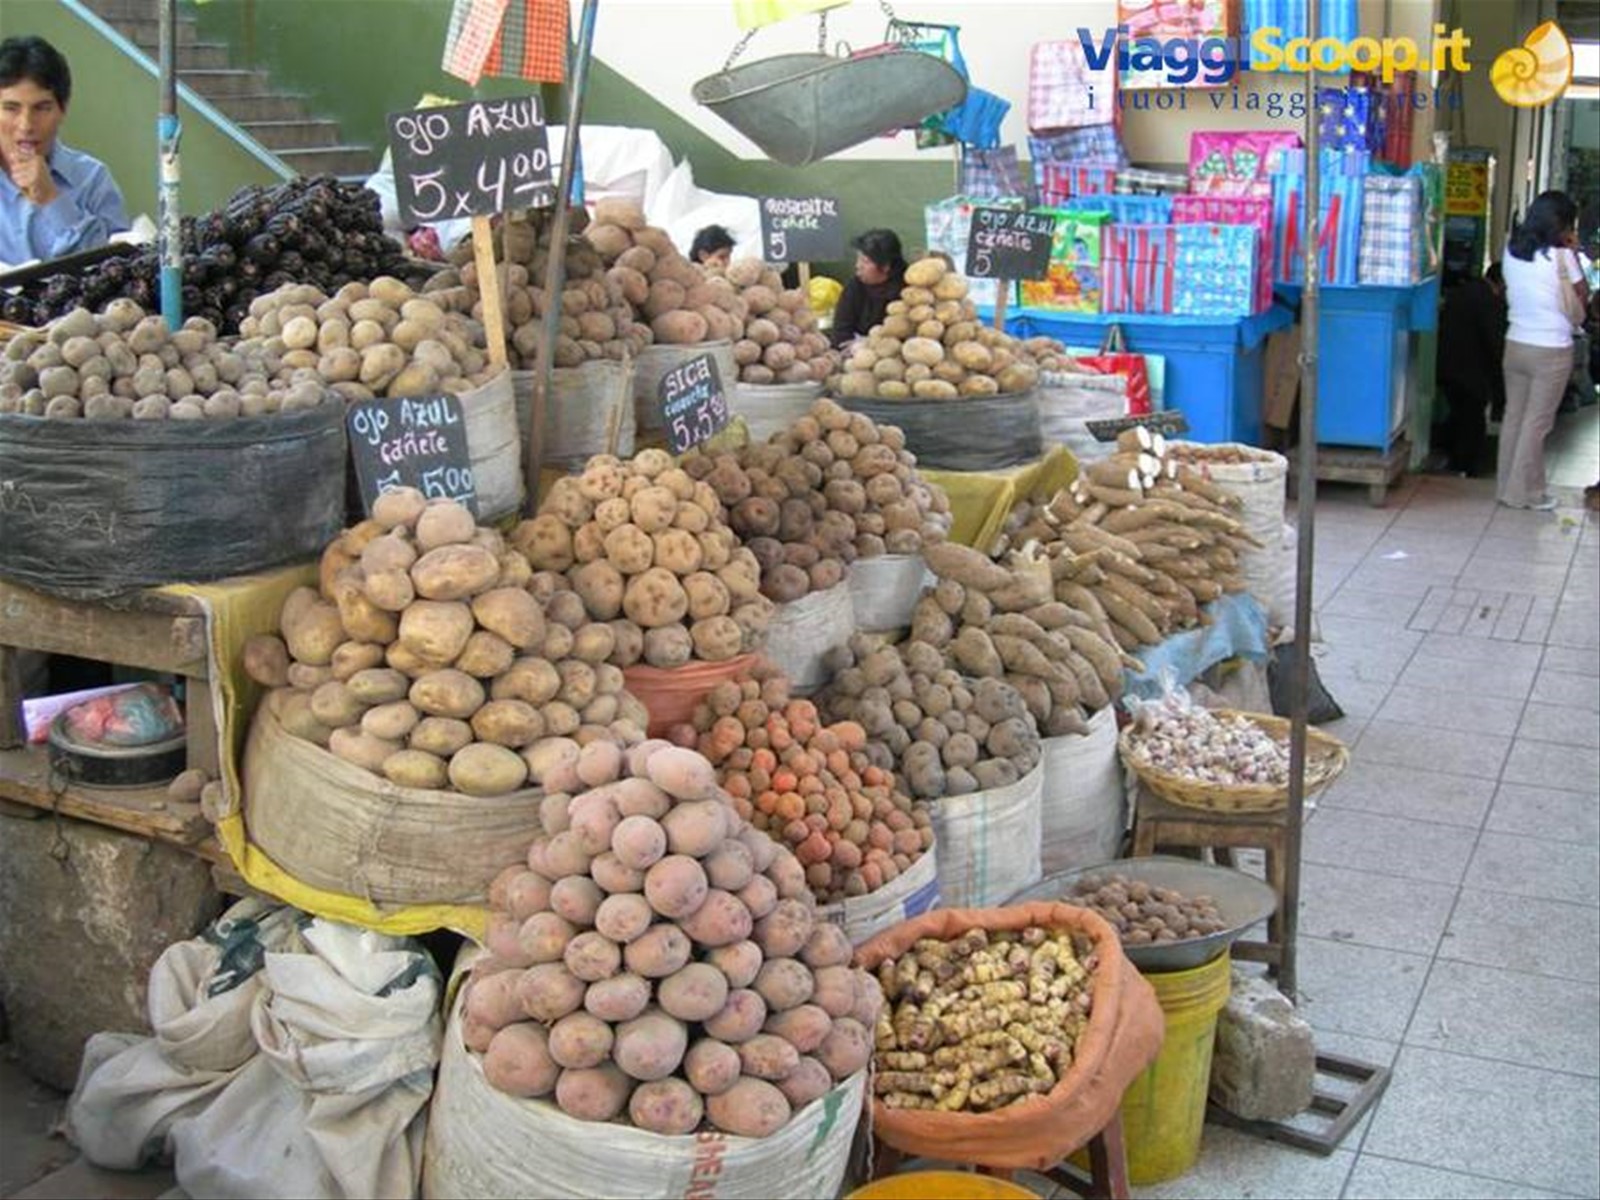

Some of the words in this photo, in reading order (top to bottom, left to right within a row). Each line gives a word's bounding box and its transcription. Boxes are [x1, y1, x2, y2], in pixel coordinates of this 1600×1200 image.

[468, 96, 545, 137] AZUL
[770, 231, 788, 260] 5
[973, 249, 992, 276] 5
[401, 397, 458, 427] AZUL
